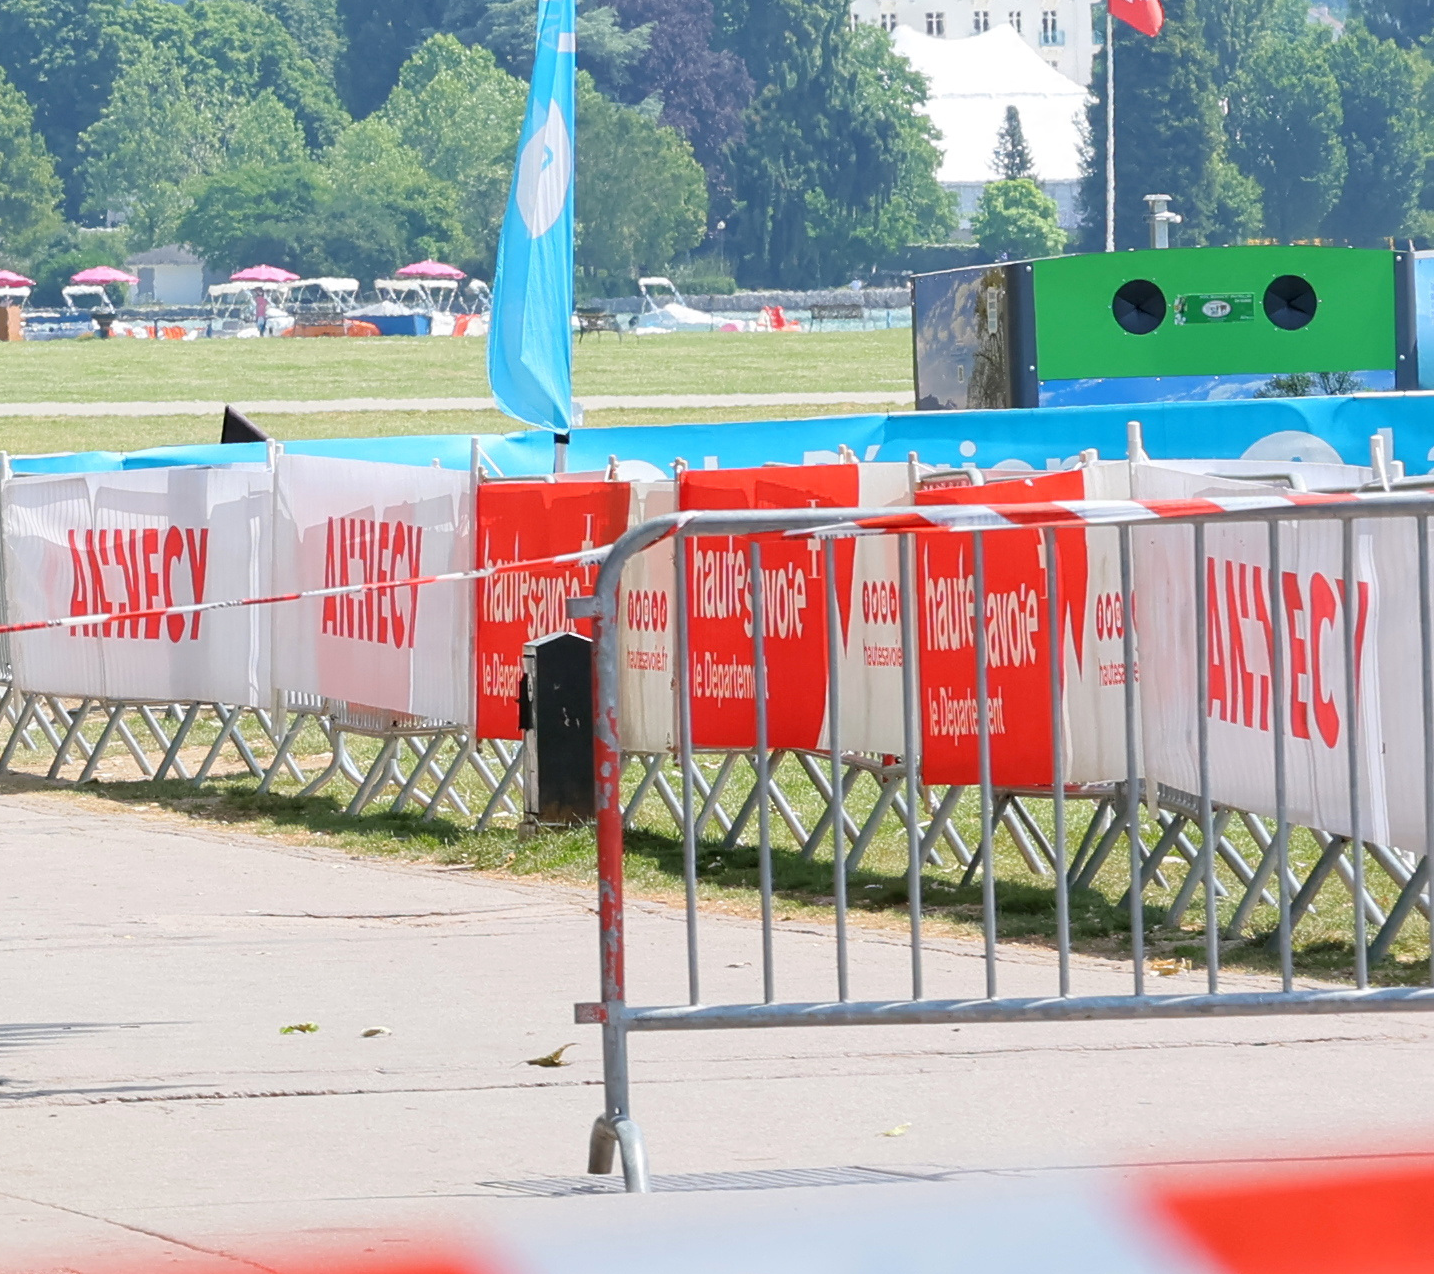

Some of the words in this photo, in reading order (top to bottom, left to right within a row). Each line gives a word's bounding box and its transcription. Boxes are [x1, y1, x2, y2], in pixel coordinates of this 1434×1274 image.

[67, 525, 209, 643] ANNECY
[322, 516, 423, 649] ANNECY
[483, 528, 530, 623] haute
[693, 536, 745, 620] haute
[923, 540, 975, 651] haute
[984, 583, 1039, 669] avoie
[482, 652, 491, 696] le
[493, 653, 523, 706] Départ
[693, 651, 702, 698] le
[705, 651, 770, 708] Départemt
[863, 638, 903, 667] hautesavoie
[928, 687, 938, 736] le
[940, 685, 1006, 747] Départeent
